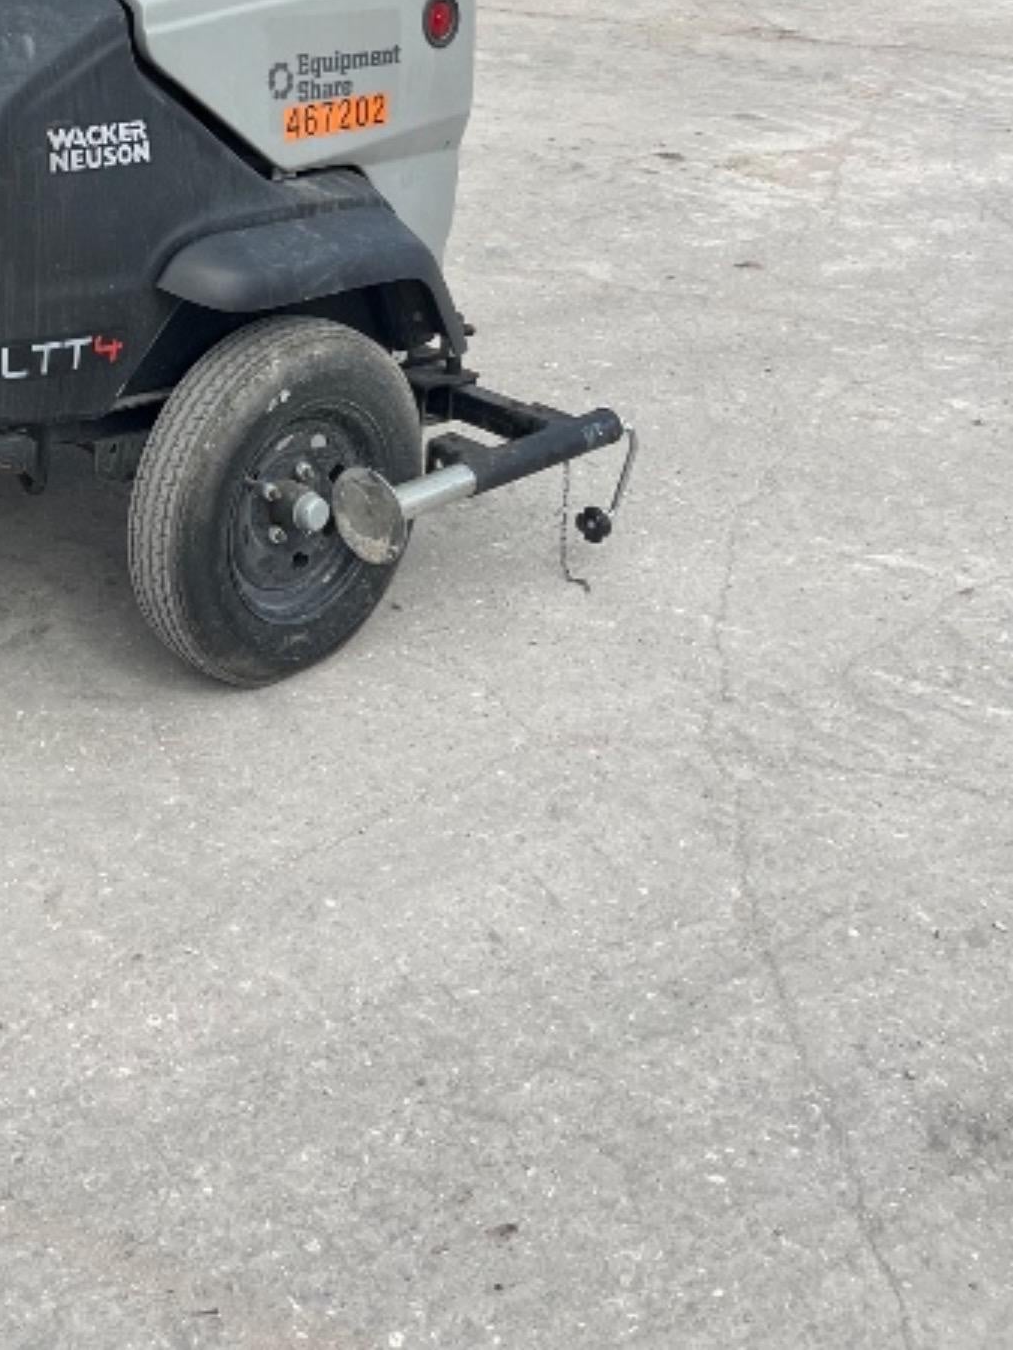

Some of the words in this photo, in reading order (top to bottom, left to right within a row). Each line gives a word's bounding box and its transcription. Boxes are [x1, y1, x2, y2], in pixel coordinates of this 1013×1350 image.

[298, 45, 401, 78] Equipment
[297, 80, 353, 101] Share
[286, 94, 385, 138] 467202
[47, 119, 148, 150] WACKER
[49, 140, 151, 173] NEUSON
